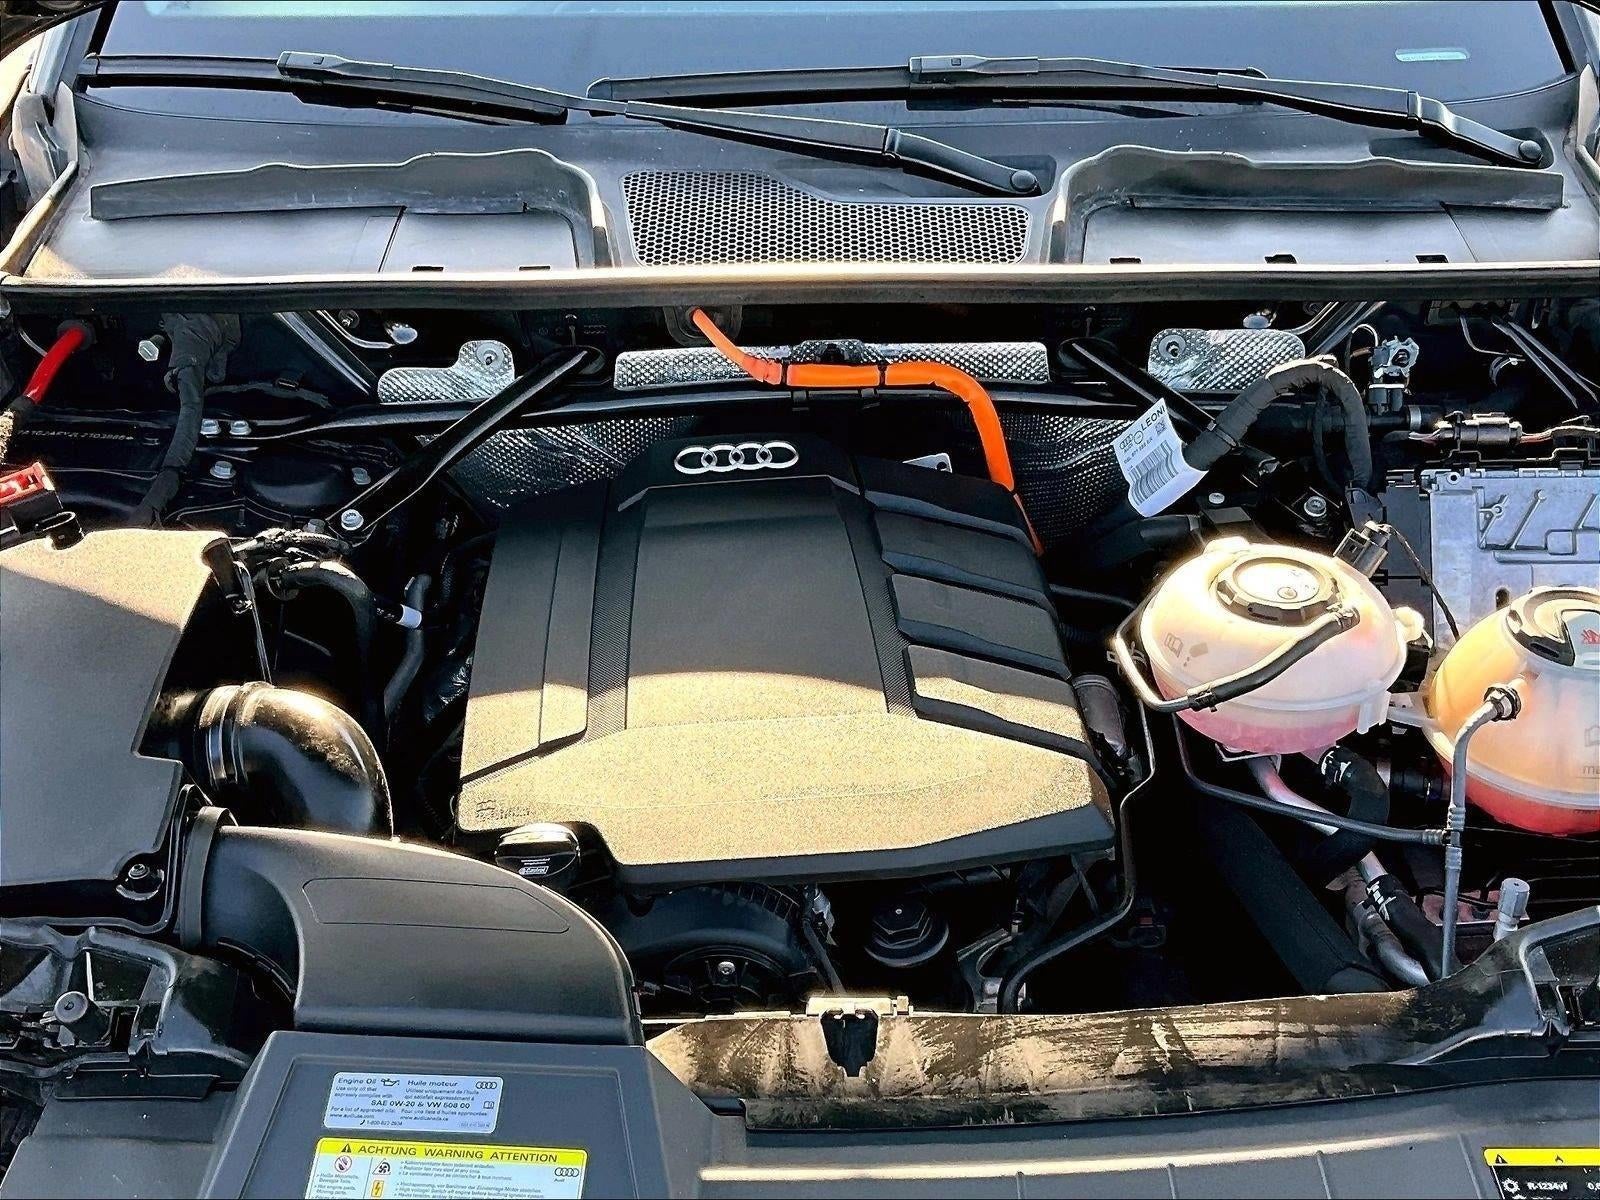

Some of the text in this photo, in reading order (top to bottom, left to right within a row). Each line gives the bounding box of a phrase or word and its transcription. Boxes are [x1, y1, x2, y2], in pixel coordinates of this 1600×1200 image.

[1141, 405, 1165, 430] LEONI
[358, 1145, 558, 1162] ACHTUNG WARNING ATTENTION
